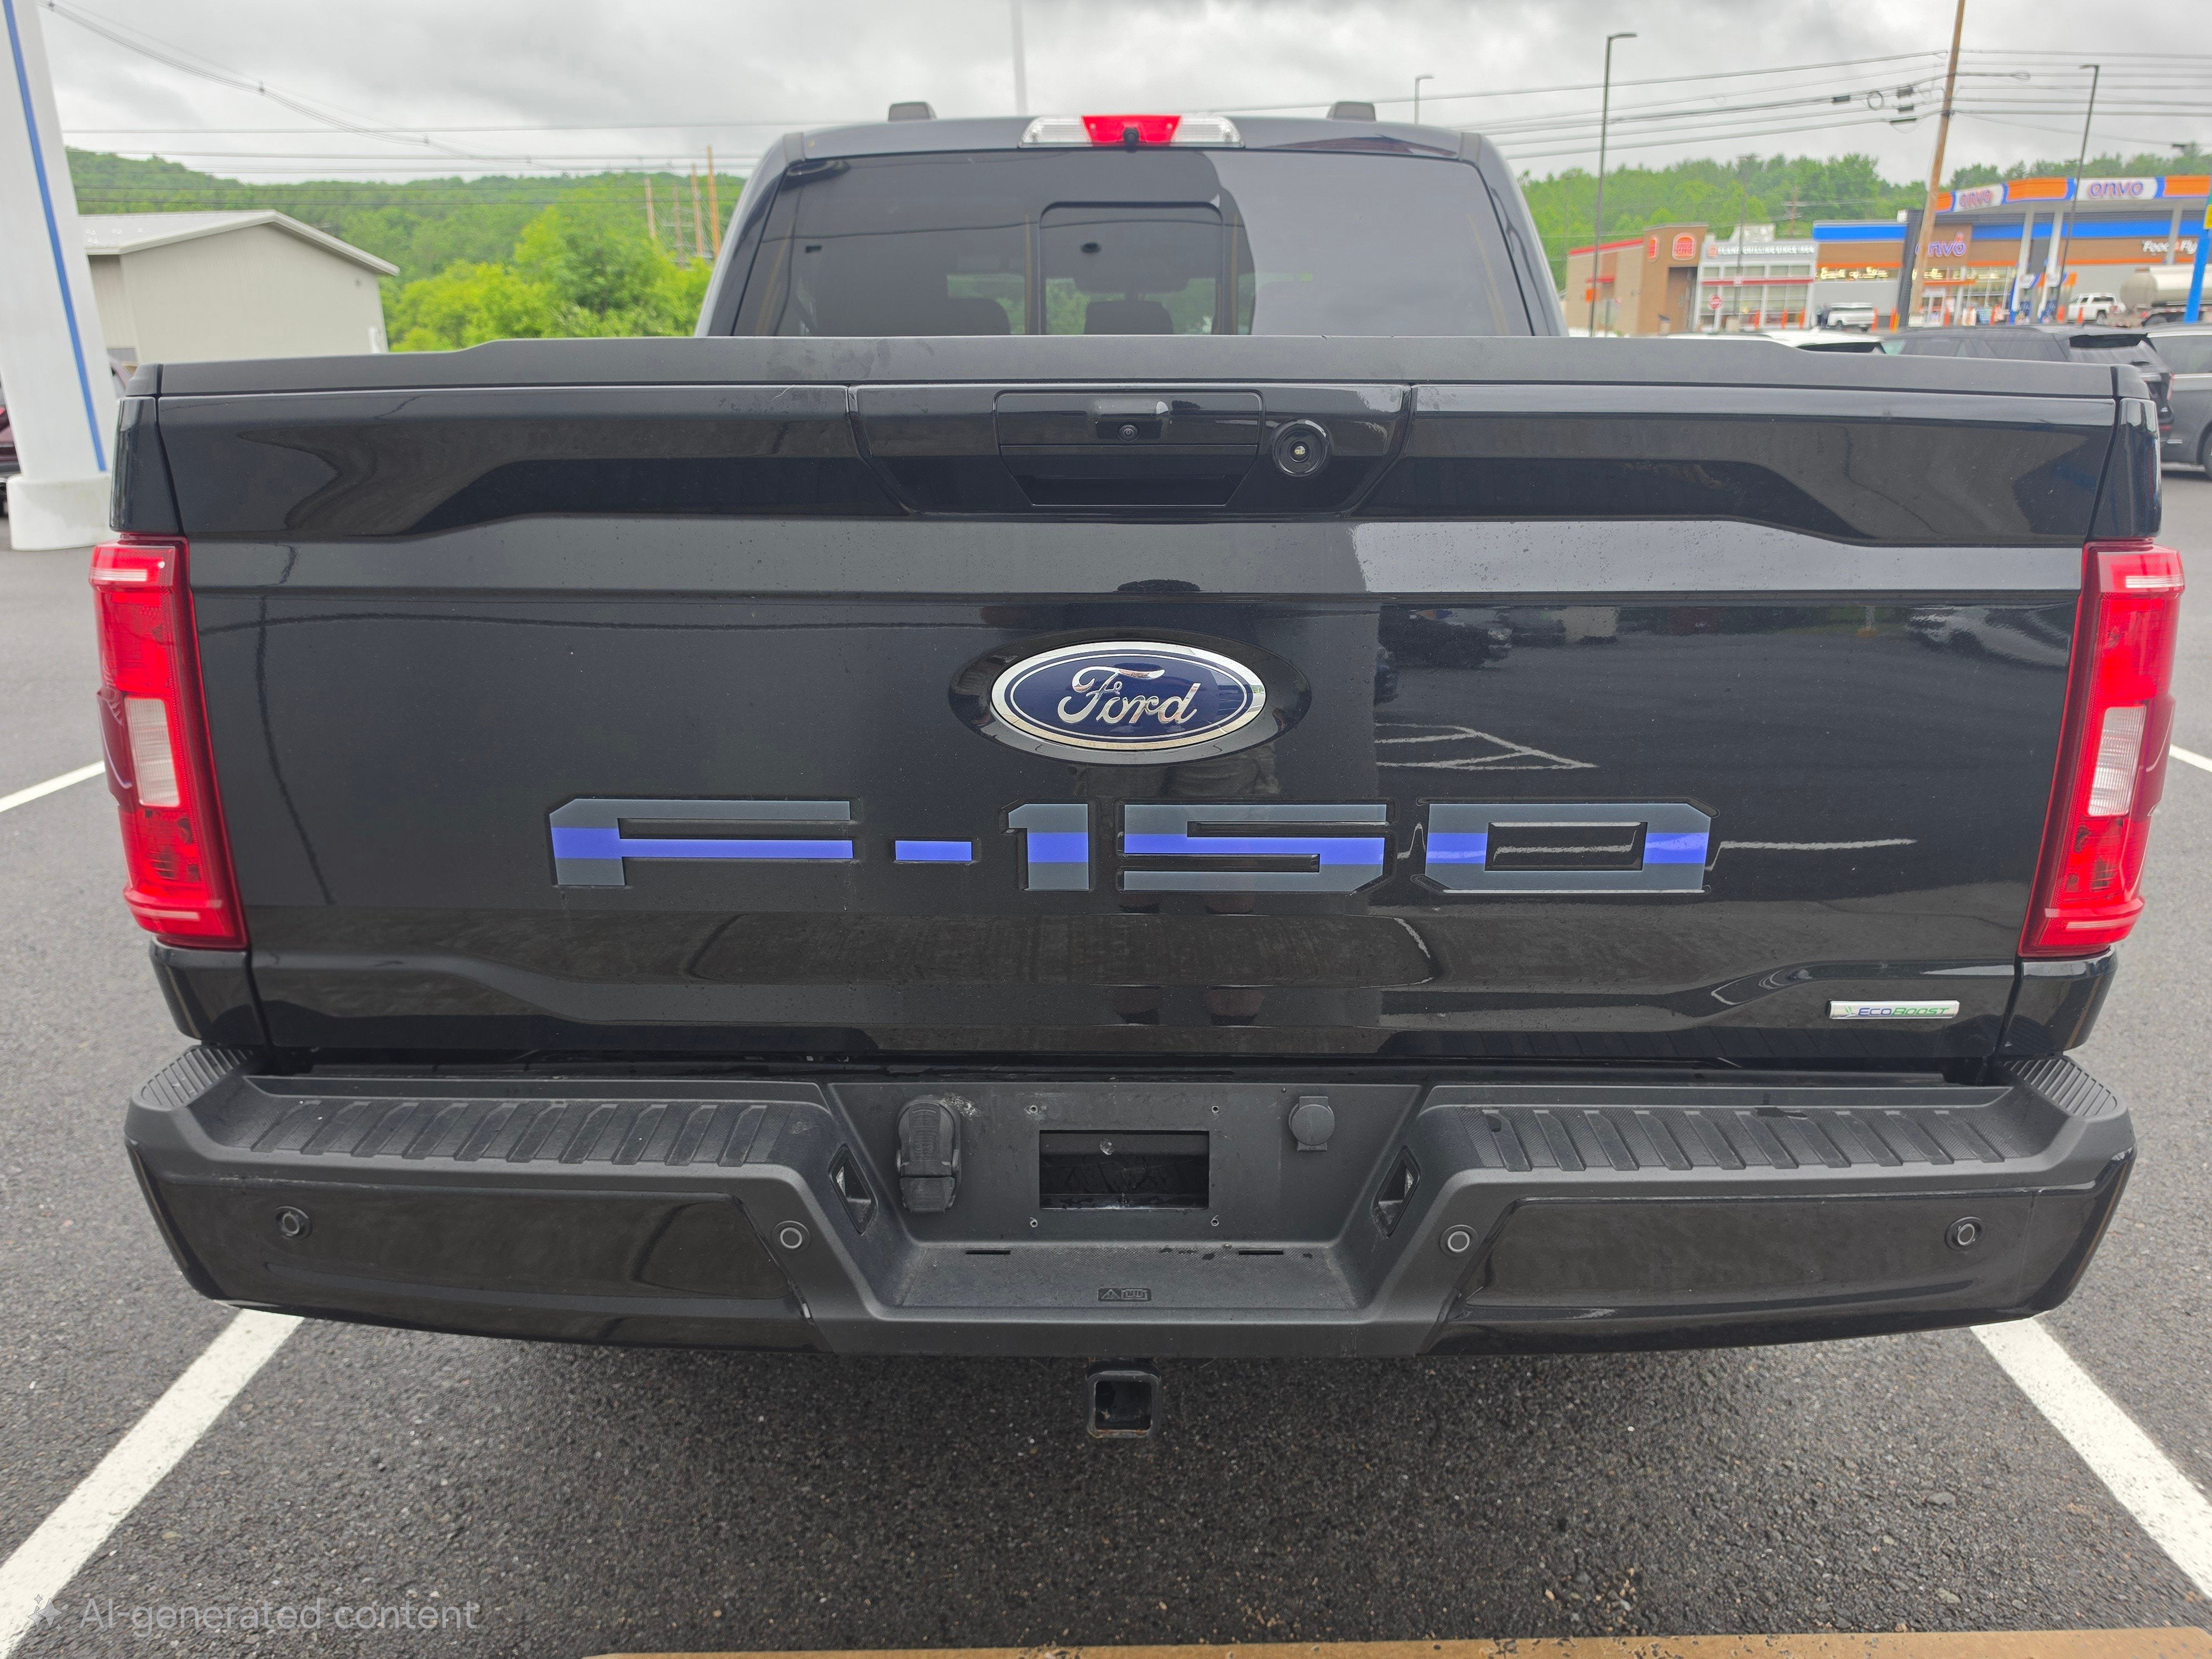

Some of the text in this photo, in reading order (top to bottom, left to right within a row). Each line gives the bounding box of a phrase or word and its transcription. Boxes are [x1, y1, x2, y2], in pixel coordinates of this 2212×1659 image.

[1959, 189, 1991, 208] onvo
[2088, 180, 2144, 199] onvo
[1057, 665, 1201, 724] Ford
[548, 797, 1714, 894] F-150
[1858, 1007, 1950, 1017] ECOBOOST
